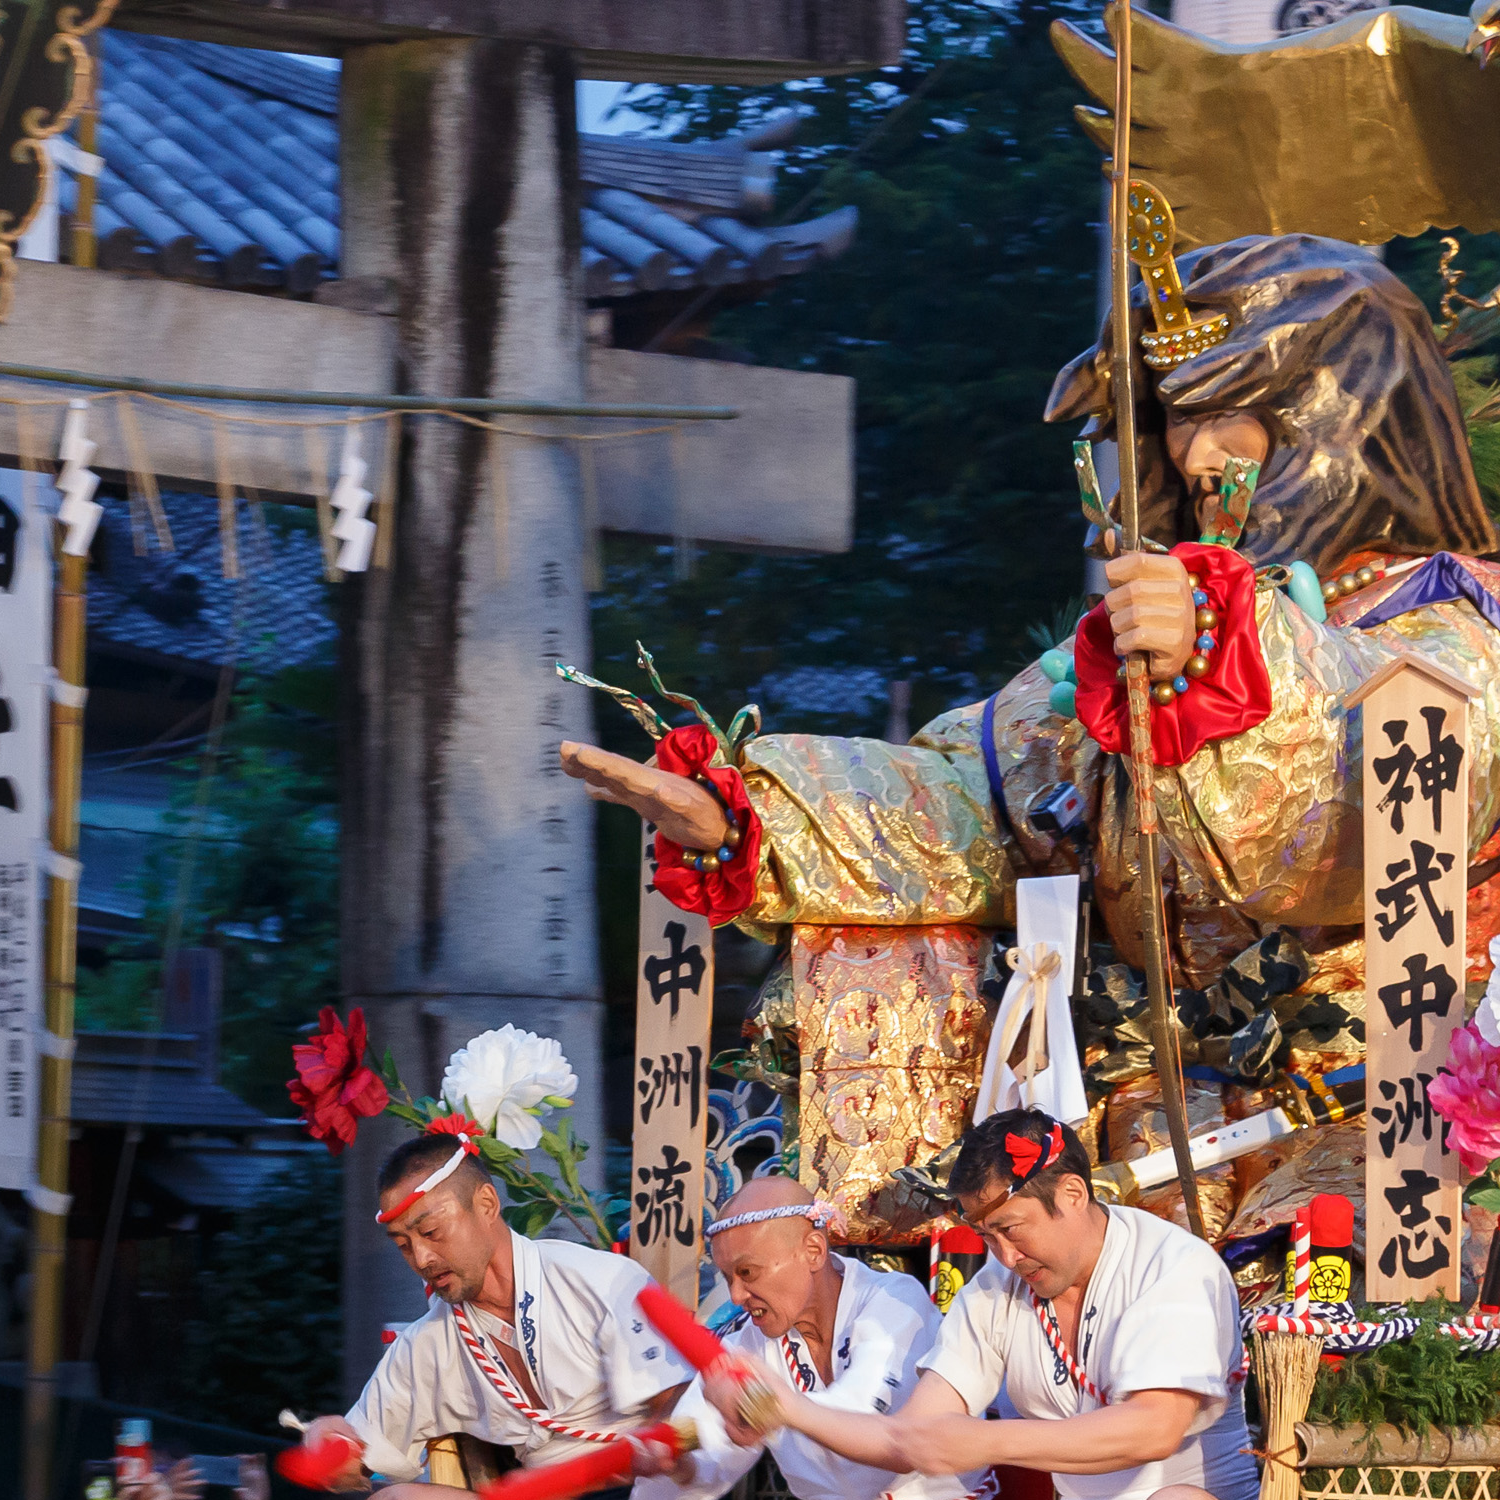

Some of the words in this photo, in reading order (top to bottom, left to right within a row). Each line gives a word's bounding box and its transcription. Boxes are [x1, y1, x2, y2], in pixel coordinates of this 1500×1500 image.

[636, 820, 706, 1247] 中洲流
[1371, 705, 1463, 1280] 神武中洲志
